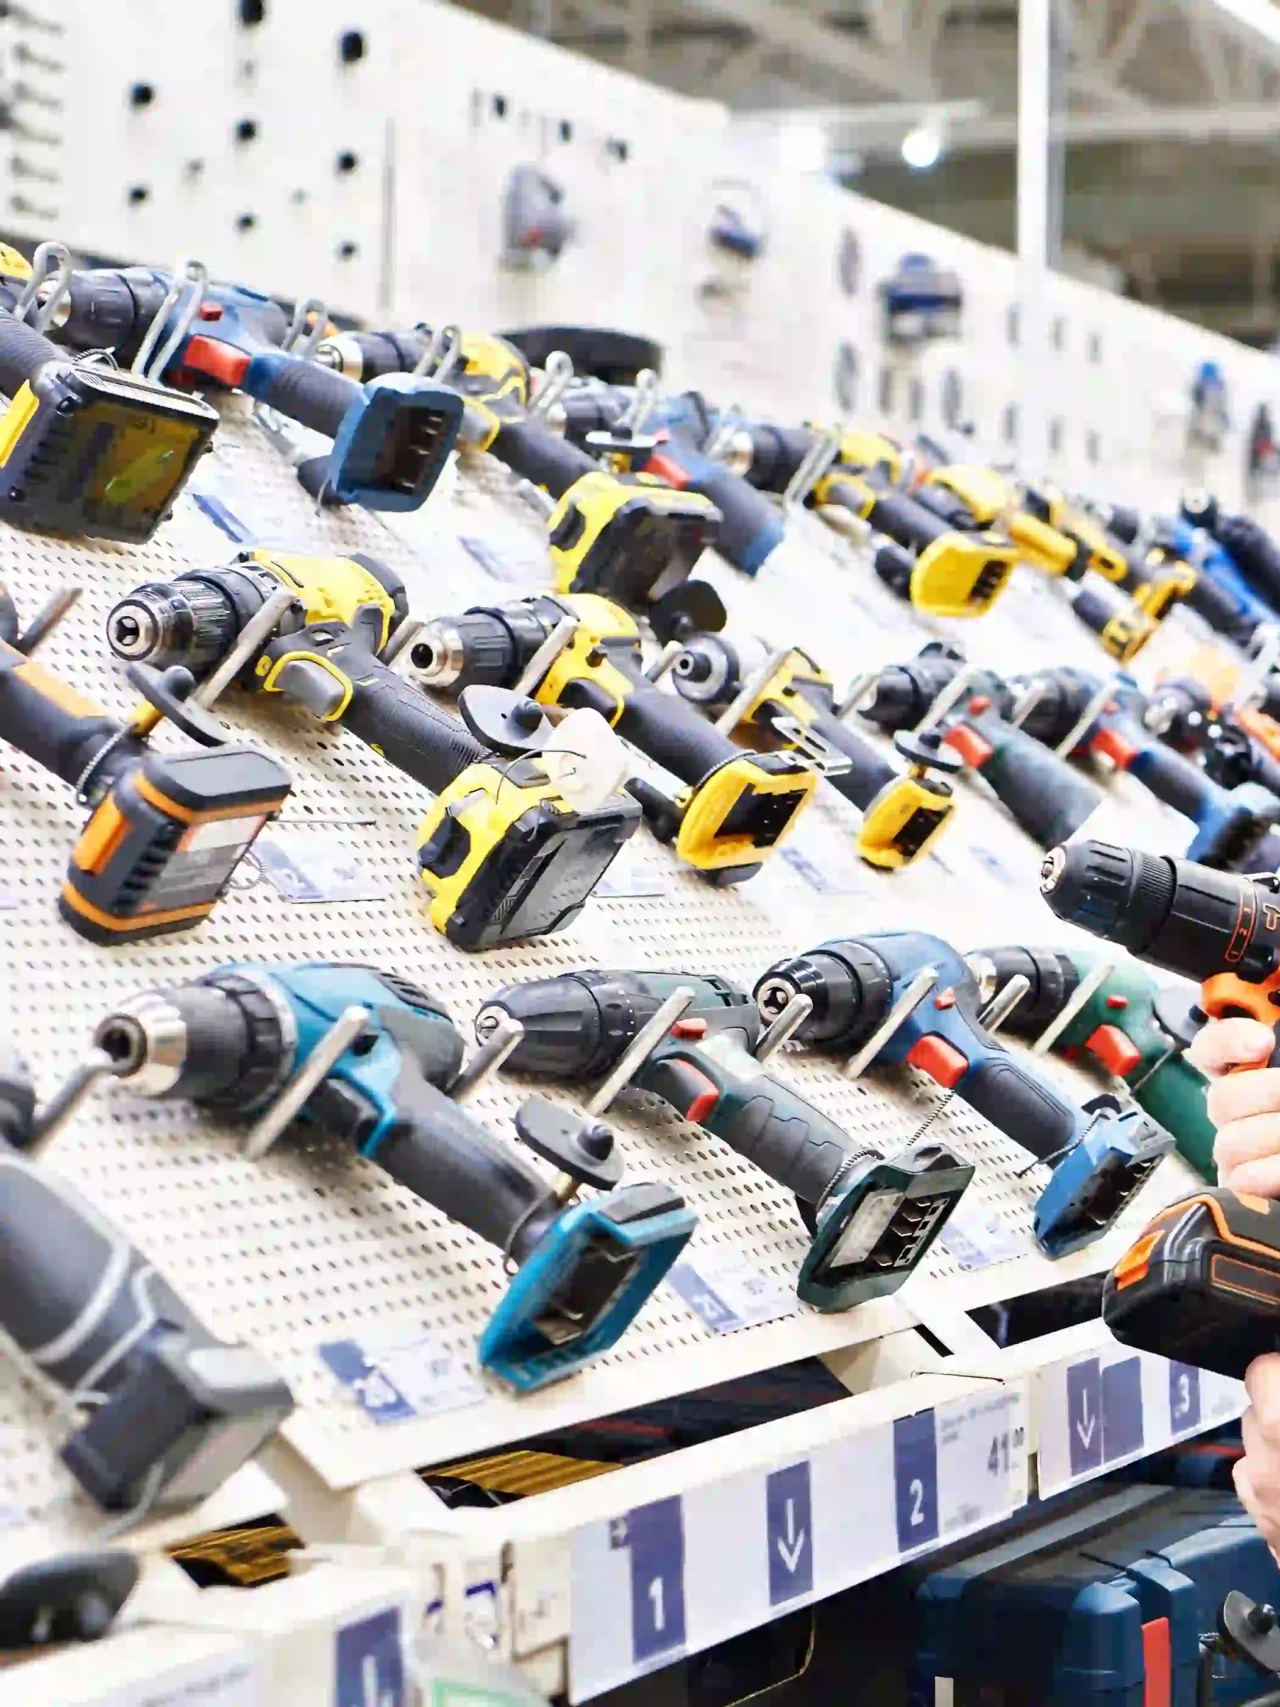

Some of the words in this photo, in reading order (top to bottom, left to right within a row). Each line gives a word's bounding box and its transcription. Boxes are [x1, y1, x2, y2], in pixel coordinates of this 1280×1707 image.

[1174, 1373, 1190, 1418] 3
[910, 1478, 924, 1526] 2
[649, 1576, 666, 1632] 1
